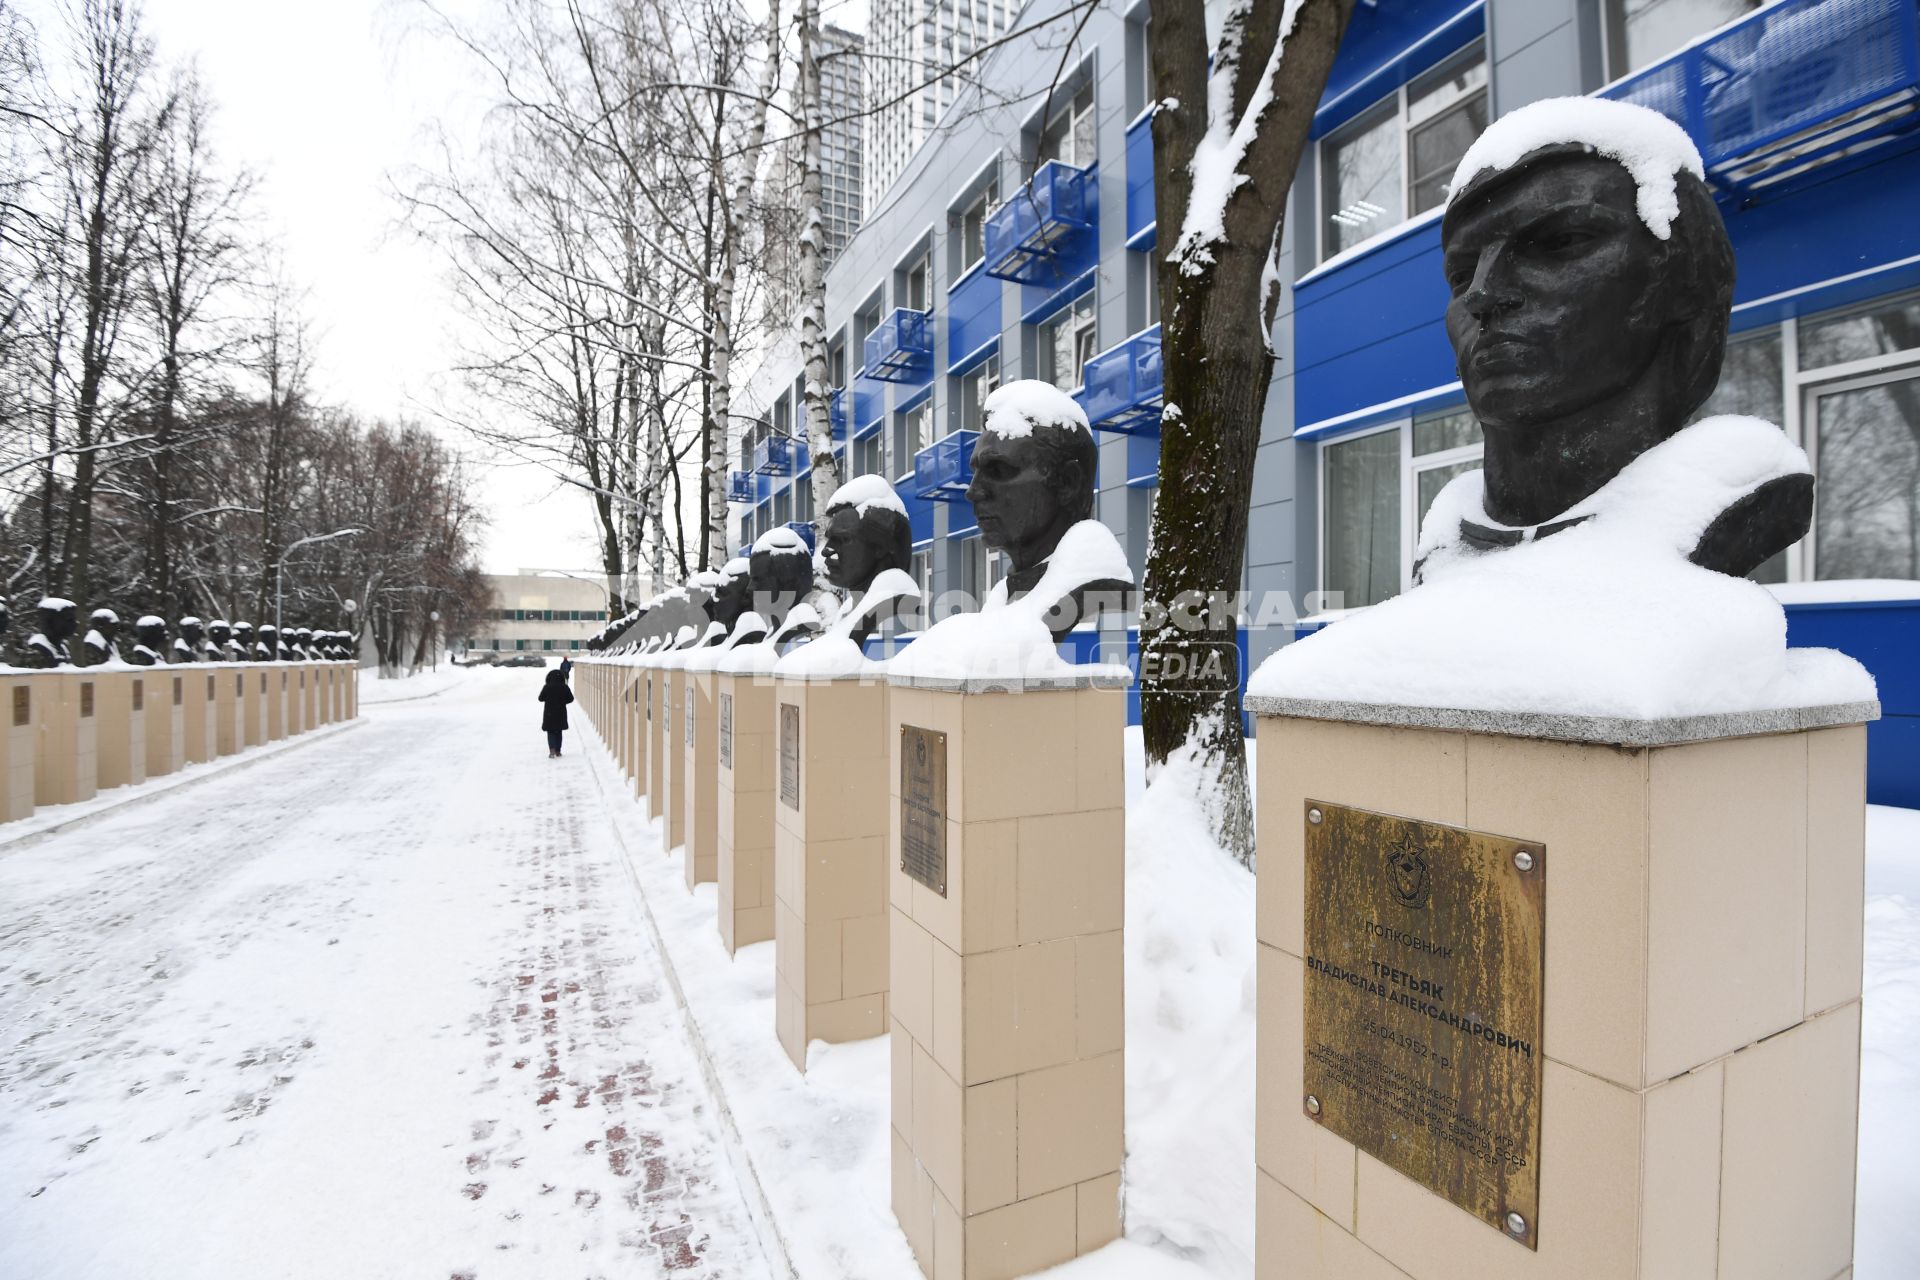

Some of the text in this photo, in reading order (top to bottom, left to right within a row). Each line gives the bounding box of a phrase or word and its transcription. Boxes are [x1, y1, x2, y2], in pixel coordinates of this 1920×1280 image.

[1365, 920, 1452, 960] ПОЛКОВНИК
[1372, 960, 1444, 1002] ТРЕТЬЯК
[1307, 956, 1531, 1058] ВЛАДИСЛАВ АЛЕКСАНДРОВИЧ
[1363, 1017, 1427, 1058] 25.04.1952
[1468, 1144, 1497, 1167] СССР
[1495, 1145, 1526, 1169] СССР
